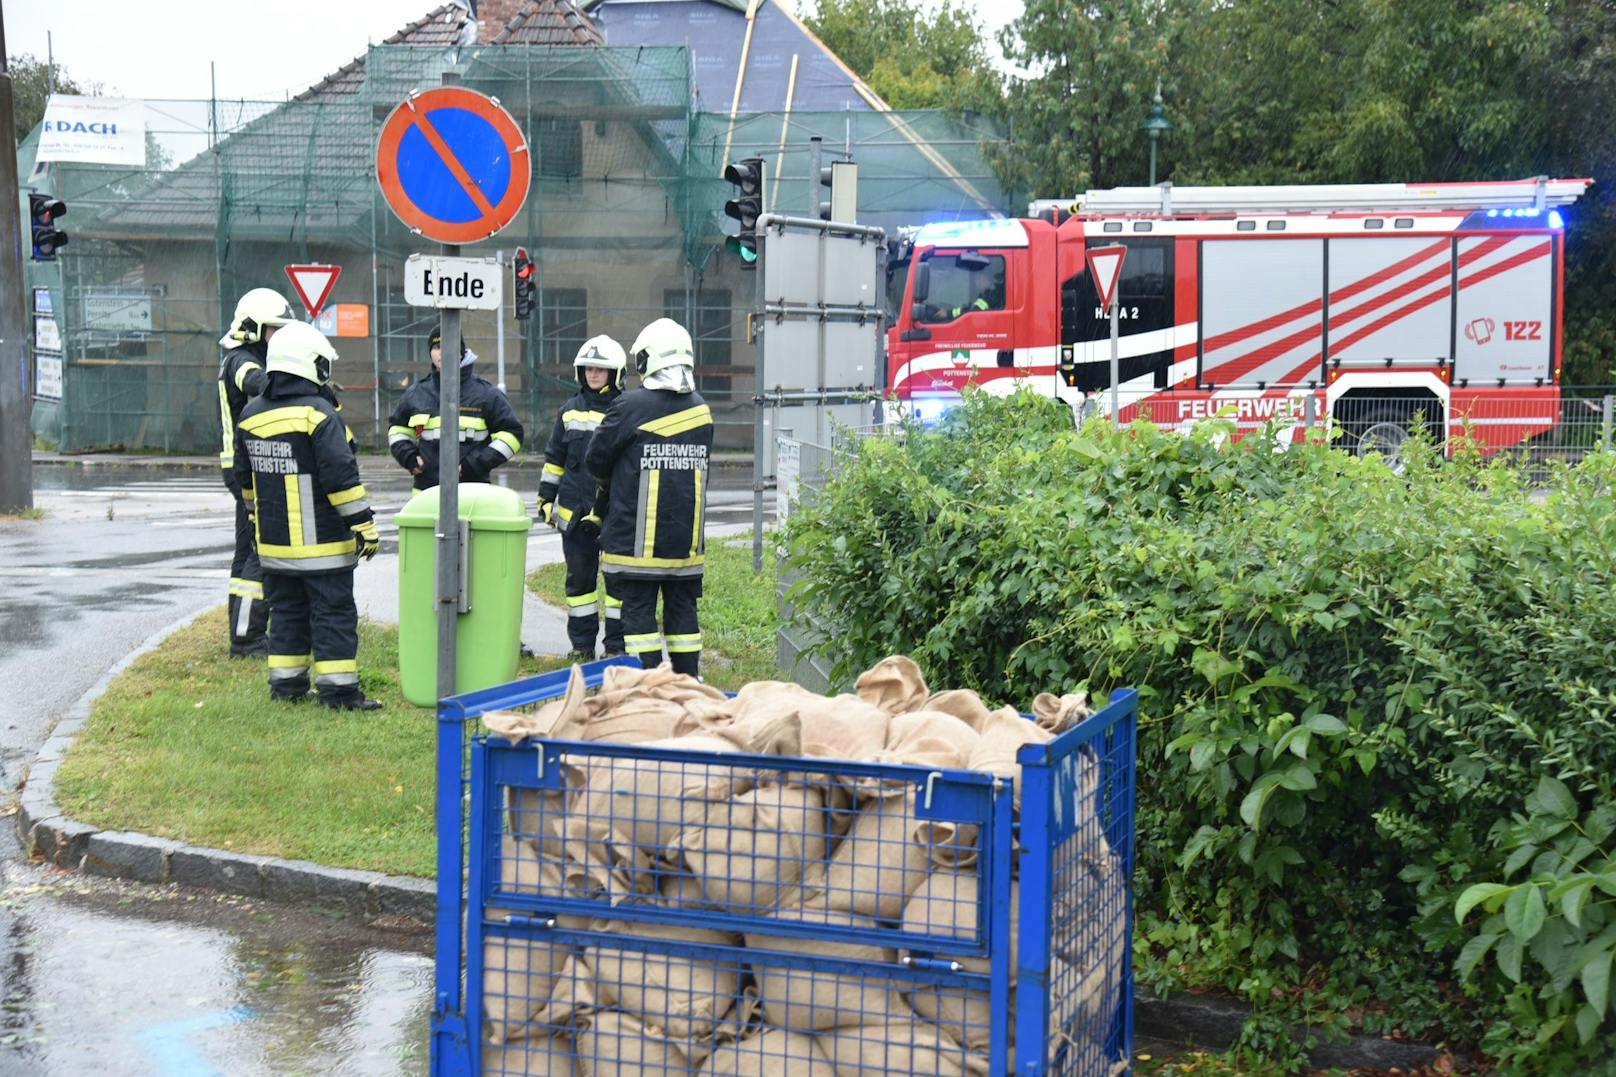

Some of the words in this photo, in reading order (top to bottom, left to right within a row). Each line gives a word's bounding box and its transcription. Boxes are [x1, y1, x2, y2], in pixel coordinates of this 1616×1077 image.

[57, 120, 116, 135] DACH
[424, 270, 484, 299] Ende
[1131, 306, 1139, 320] 2
[1503, 320, 1542, 341] 122
[643, 443, 707, 457] FEUERWEHR
[640, 456, 709, 470] POTTENSTEIN
